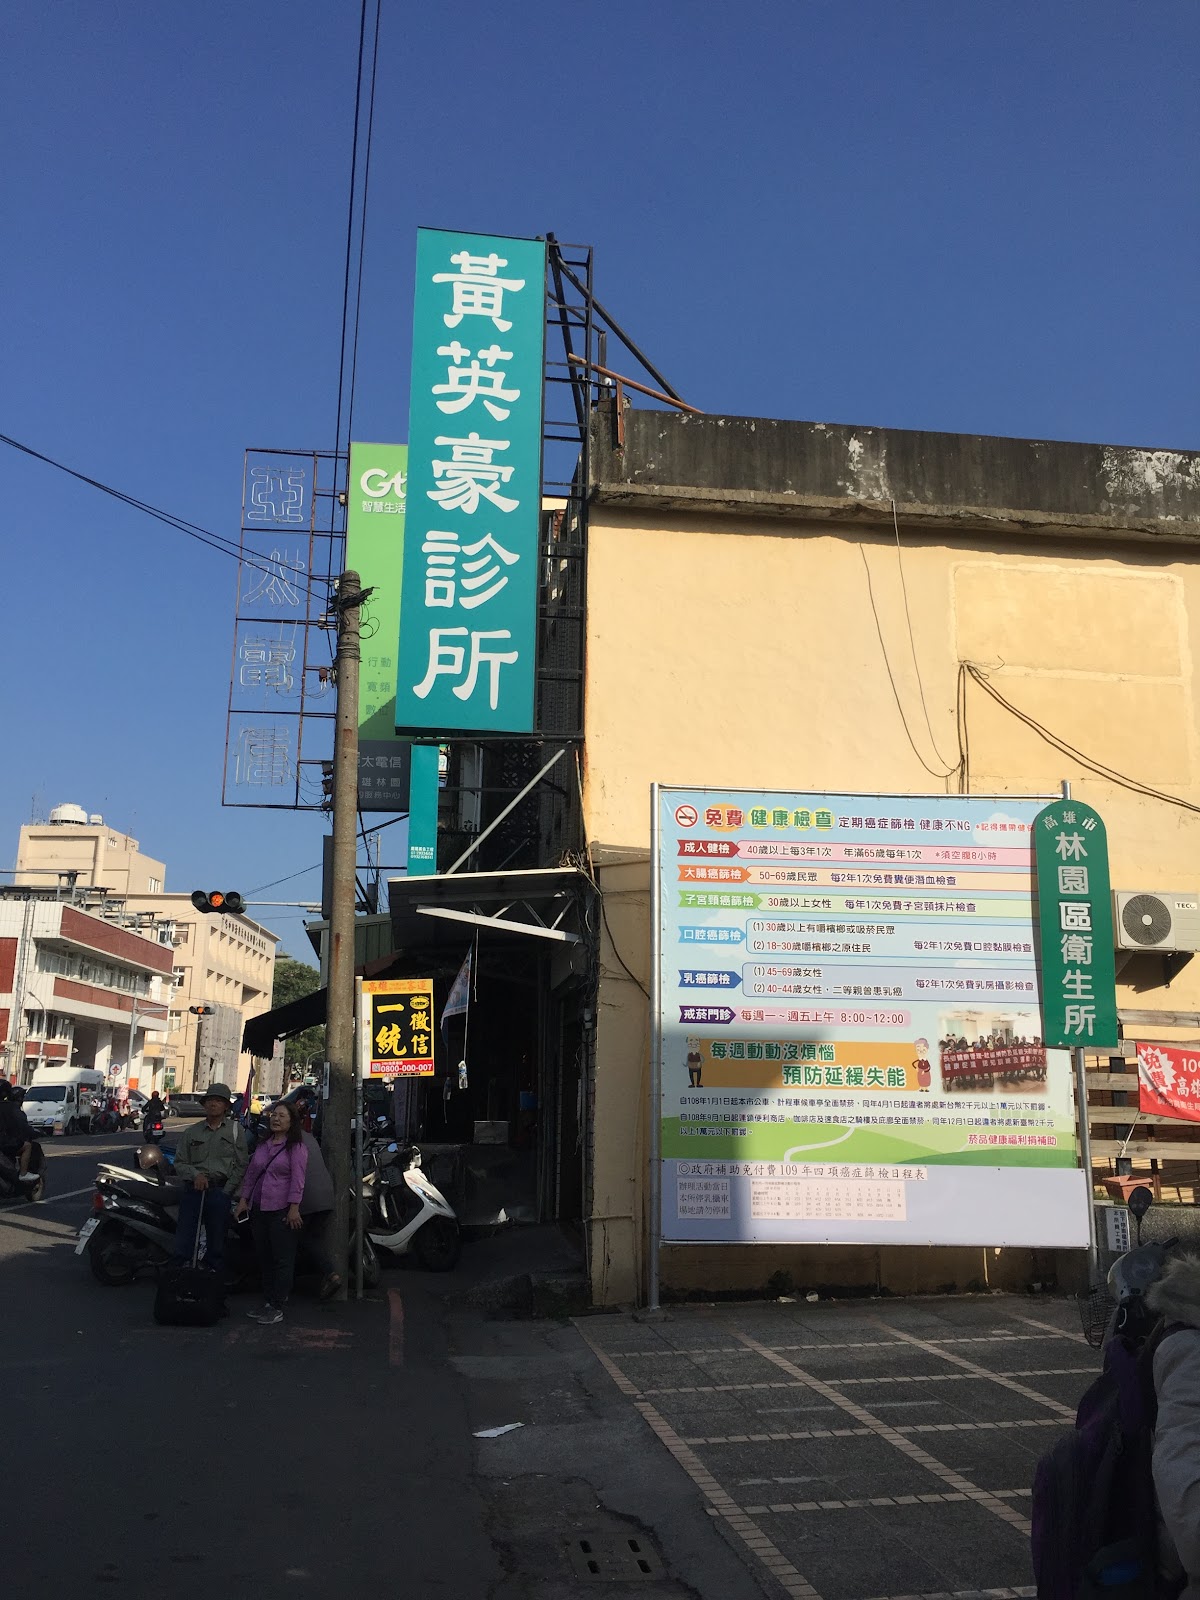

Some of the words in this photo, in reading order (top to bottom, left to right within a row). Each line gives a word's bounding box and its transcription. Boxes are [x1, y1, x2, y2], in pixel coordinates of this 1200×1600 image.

[413, 251, 526, 711] 黃英豪診所
[362, 501, 405, 513] 智慧生活
[368, 657, 391, 667] 行動
[367, 682, 391, 692] 寬頻
[705, 809, 743, 826] 免費
[750, 810, 833, 828] 健康檢查
[838, 817, 915, 830] 定期癌症篩檢
[1042, 810, 1098, 832] 高雄市
[684, 843, 730, 854] 成人健檢
[747, 845, 831, 857] 40歲以上每3年1次
[844, 848, 922, 859] 年滿65歲每年1次
[685, 868, 742, 880] 大腸癌篩檢
[759, 871, 818, 882] 50-69歲民眾
[685, 894, 754, 906] 子宮頸癌篩檢
[768, 897, 832, 908] 30歲以上女性
[684, 930, 741, 941] 口腔癌篩檢
[1055, 832, 1096, 1036] 林園區衛生所
[684, 973, 730, 984] 乳癌篩檢
[684, 1009, 731, 1020] 戒菸門診
[375, 1003, 407, 1056] 一統
[409, 1011, 431, 1055] 徵信
[710, 1042, 835, 1061] 每週動動沒煩惱
[783, 1065, 905, 1087] 預防延緩失能
[1144, 1053, 1168, 1088] 免費
[968, 1134, 1057, 1146] 菸品健康福利捐補助
